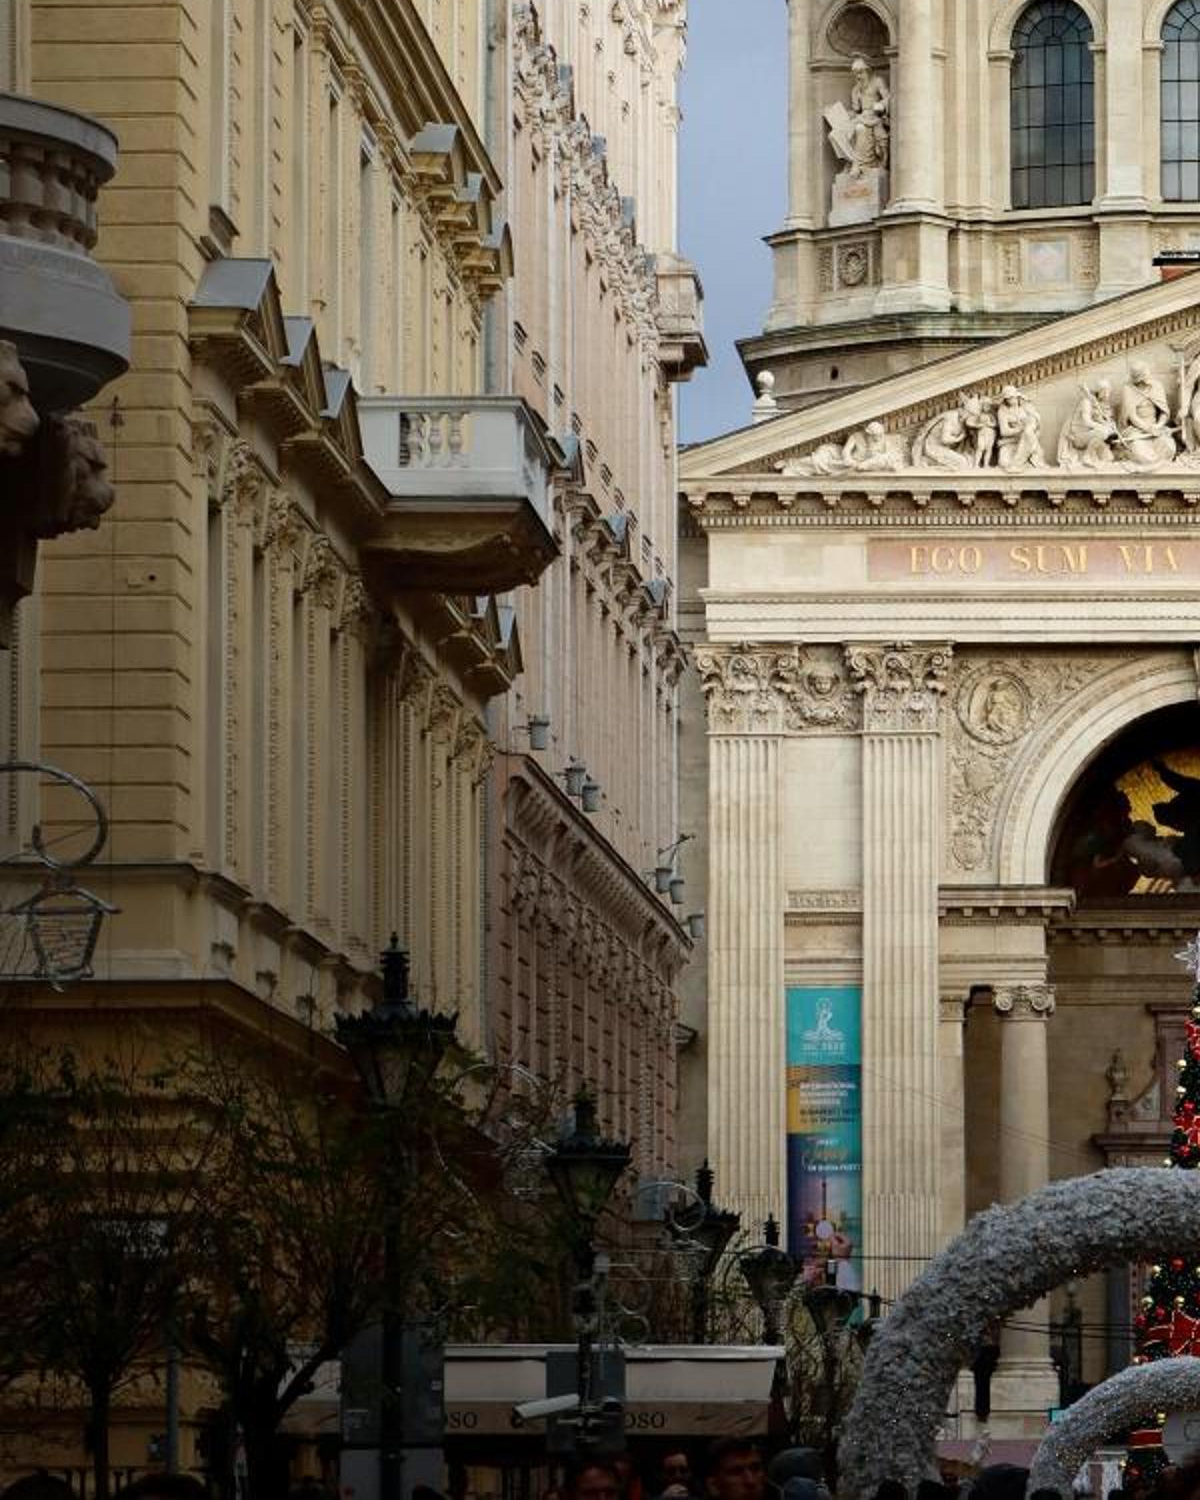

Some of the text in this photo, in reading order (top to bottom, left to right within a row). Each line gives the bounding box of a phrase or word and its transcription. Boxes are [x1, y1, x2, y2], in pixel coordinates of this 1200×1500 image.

[909, 545, 983, 573] EGO
[1009, 545, 1089, 573] SUM
[1118, 545, 1180, 573] VIA
